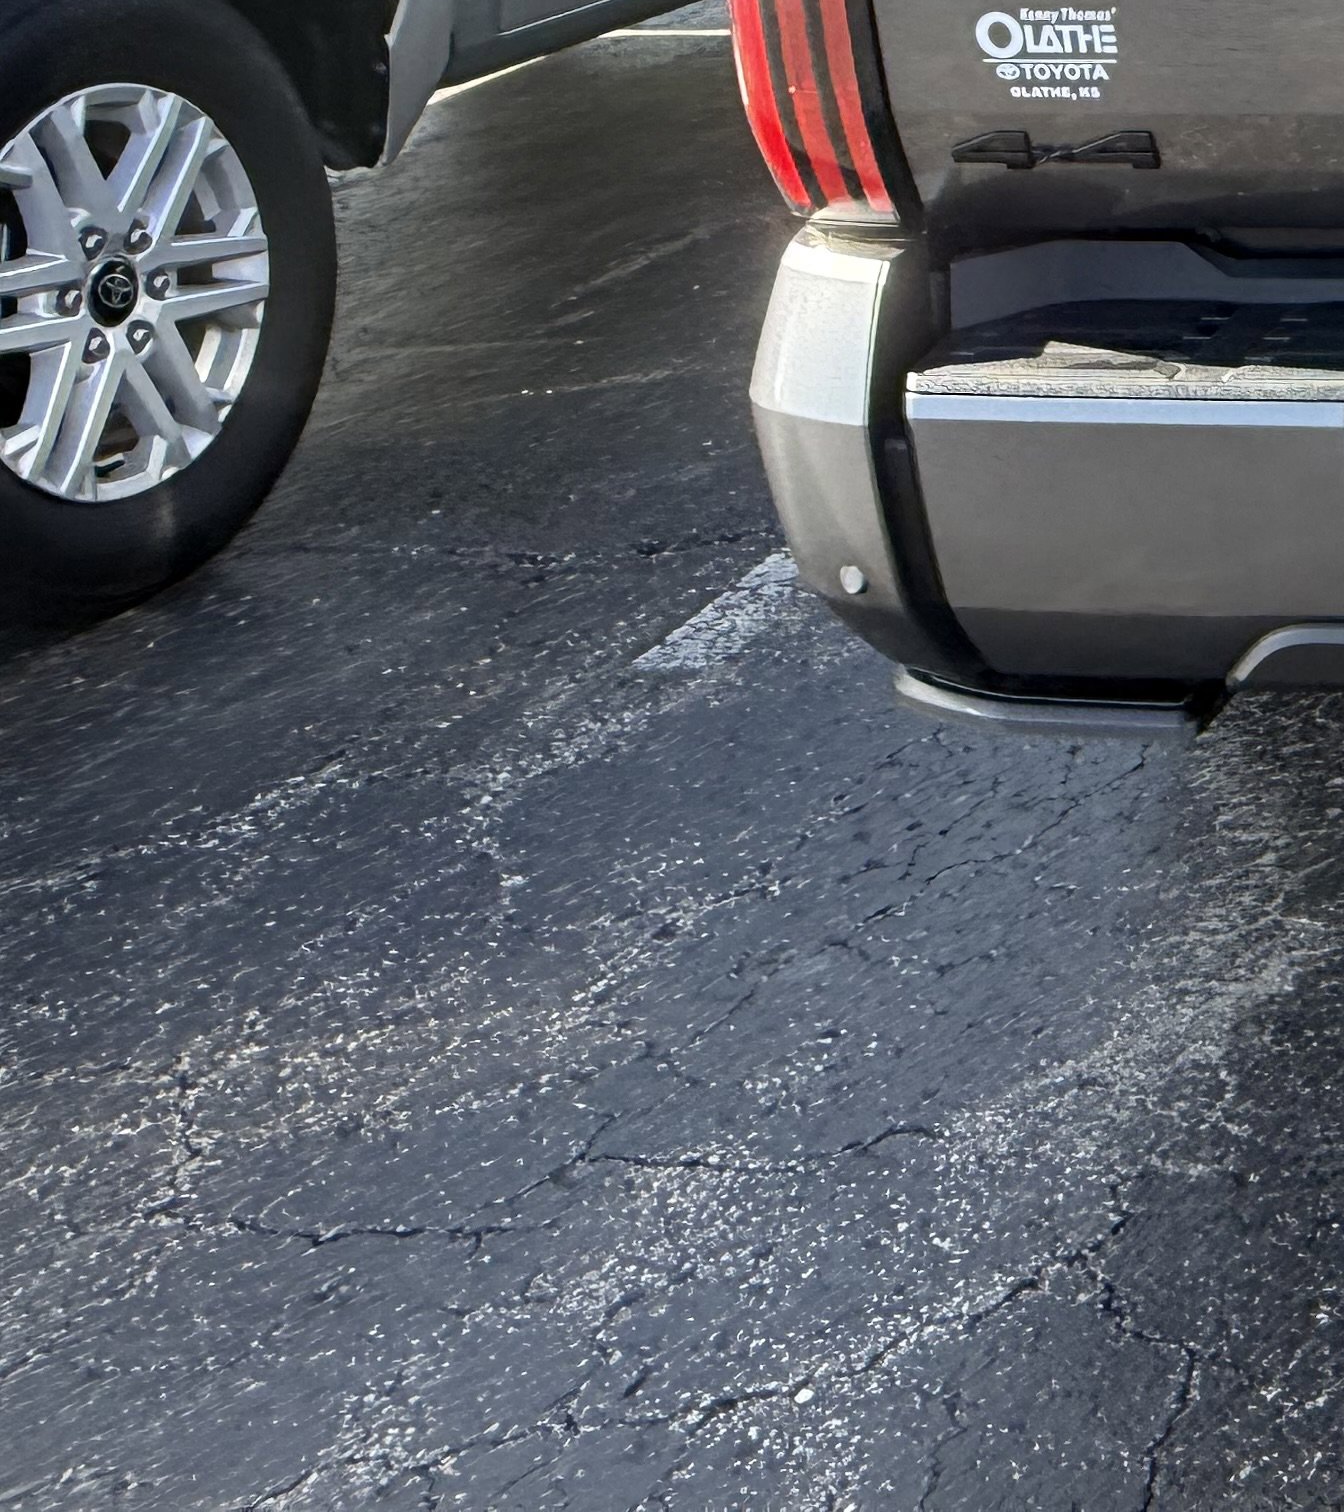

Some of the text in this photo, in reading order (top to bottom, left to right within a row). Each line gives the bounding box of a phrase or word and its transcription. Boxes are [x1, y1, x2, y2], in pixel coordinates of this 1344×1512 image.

[1019, 7, 1059, 24] Kenny
[975, 11, 1119, 59] OLATHE
[1019, 63, 1110, 81] TOYOTA
[1009, 86, 1078, 101] OLATHE,
